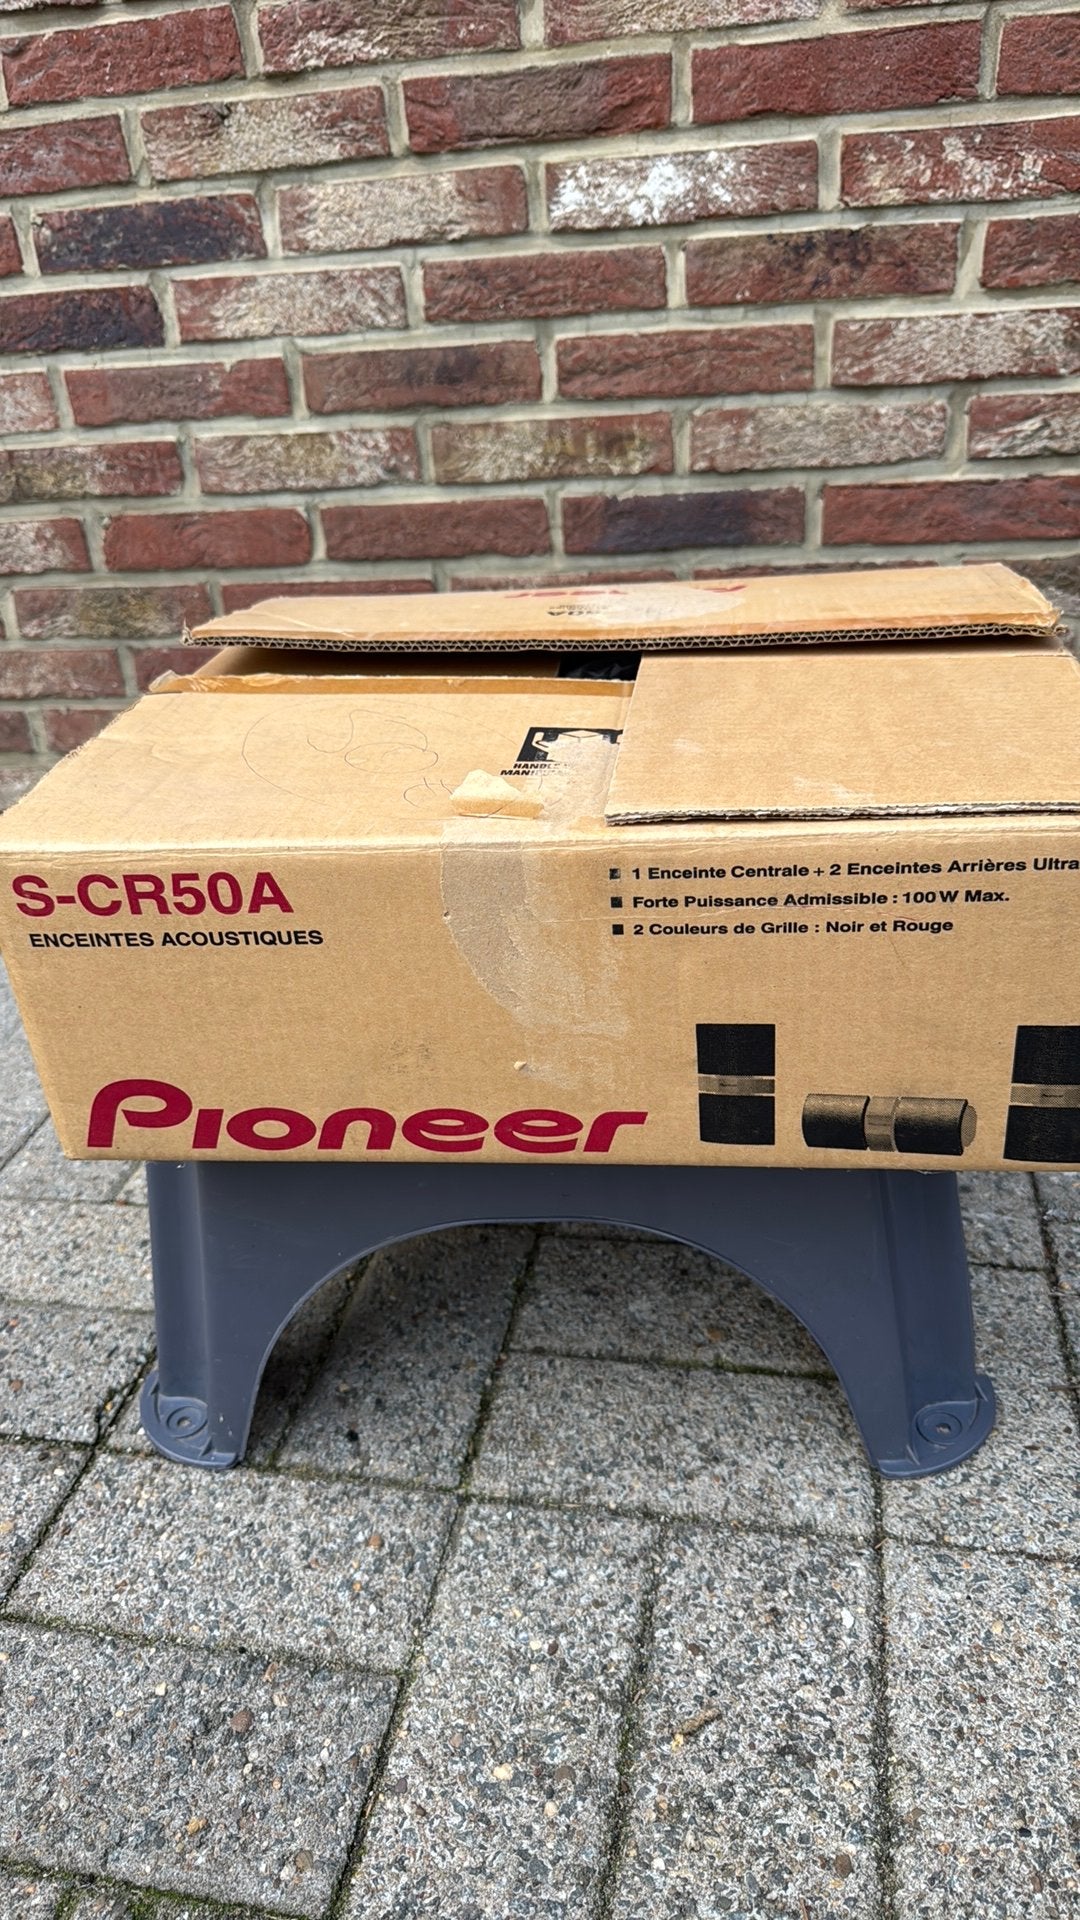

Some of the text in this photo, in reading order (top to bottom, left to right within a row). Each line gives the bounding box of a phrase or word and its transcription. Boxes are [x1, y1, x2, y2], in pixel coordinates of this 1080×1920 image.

[632, 868, 641, 880] 1
[648, 866, 727, 880] Enceinte
[731, 864, 810, 879] Centrale
[829, 864, 842, 876] 2
[847, 861, 943, 876] Enceintes
[947, 858, 1027, 873] Arrières
[1033, 857, 1080, 871] Ultra
[11, 871, 295, 918] S-CR50A
[632, 896, 679, 909] Forte
[684, 895, 779, 908] Puissance
[783, 892, 889, 907] Admissible
[902, 891, 937, 904] 100
[938, 890, 960, 903] W
[964, 890, 1010, 903] Max.
[633, 924, 644, 936] 2
[648, 923, 729, 936] Couleurs
[733, 922, 756, 935] de
[760, 921, 809, 934] Grille
[825, 921, 865, 934] Noir
[869, 921, 888, 932] et
[892, 920, 954, 934] Rouge
[29, 930, 324, 948] ENCEINTES ACOUSTIQUES
[87, 1078, 649, 1153] Pioneer
